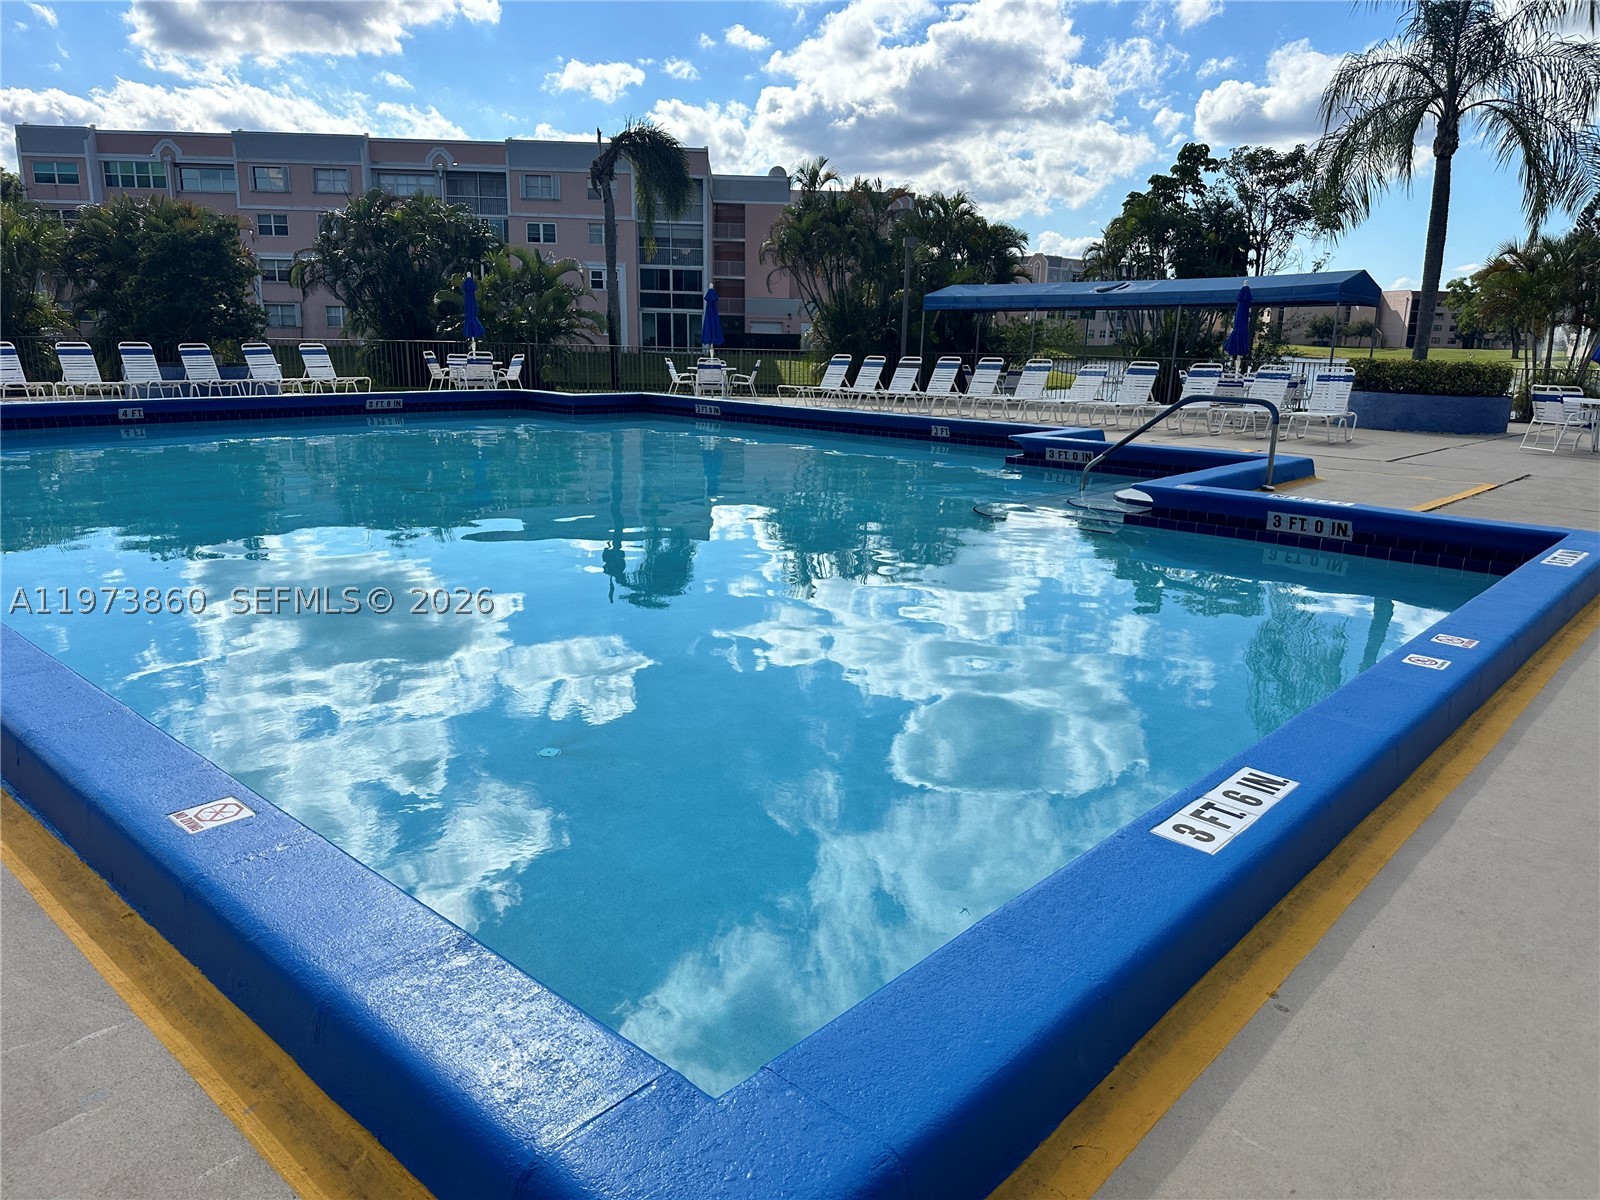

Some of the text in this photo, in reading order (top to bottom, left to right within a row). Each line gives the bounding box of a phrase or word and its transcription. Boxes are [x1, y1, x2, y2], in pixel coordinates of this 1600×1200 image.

[122, 409, 128, 418] 4
[934, 426, 938, 435] 3
[1049, 449, 1055, 459] 3
[1072, 451, 1078, 461] 0
[1272, 514, 1350, 538] 3 FT. 0 IN.
[1172, 772, 1290, 843] 3 FT. 6 IN.
